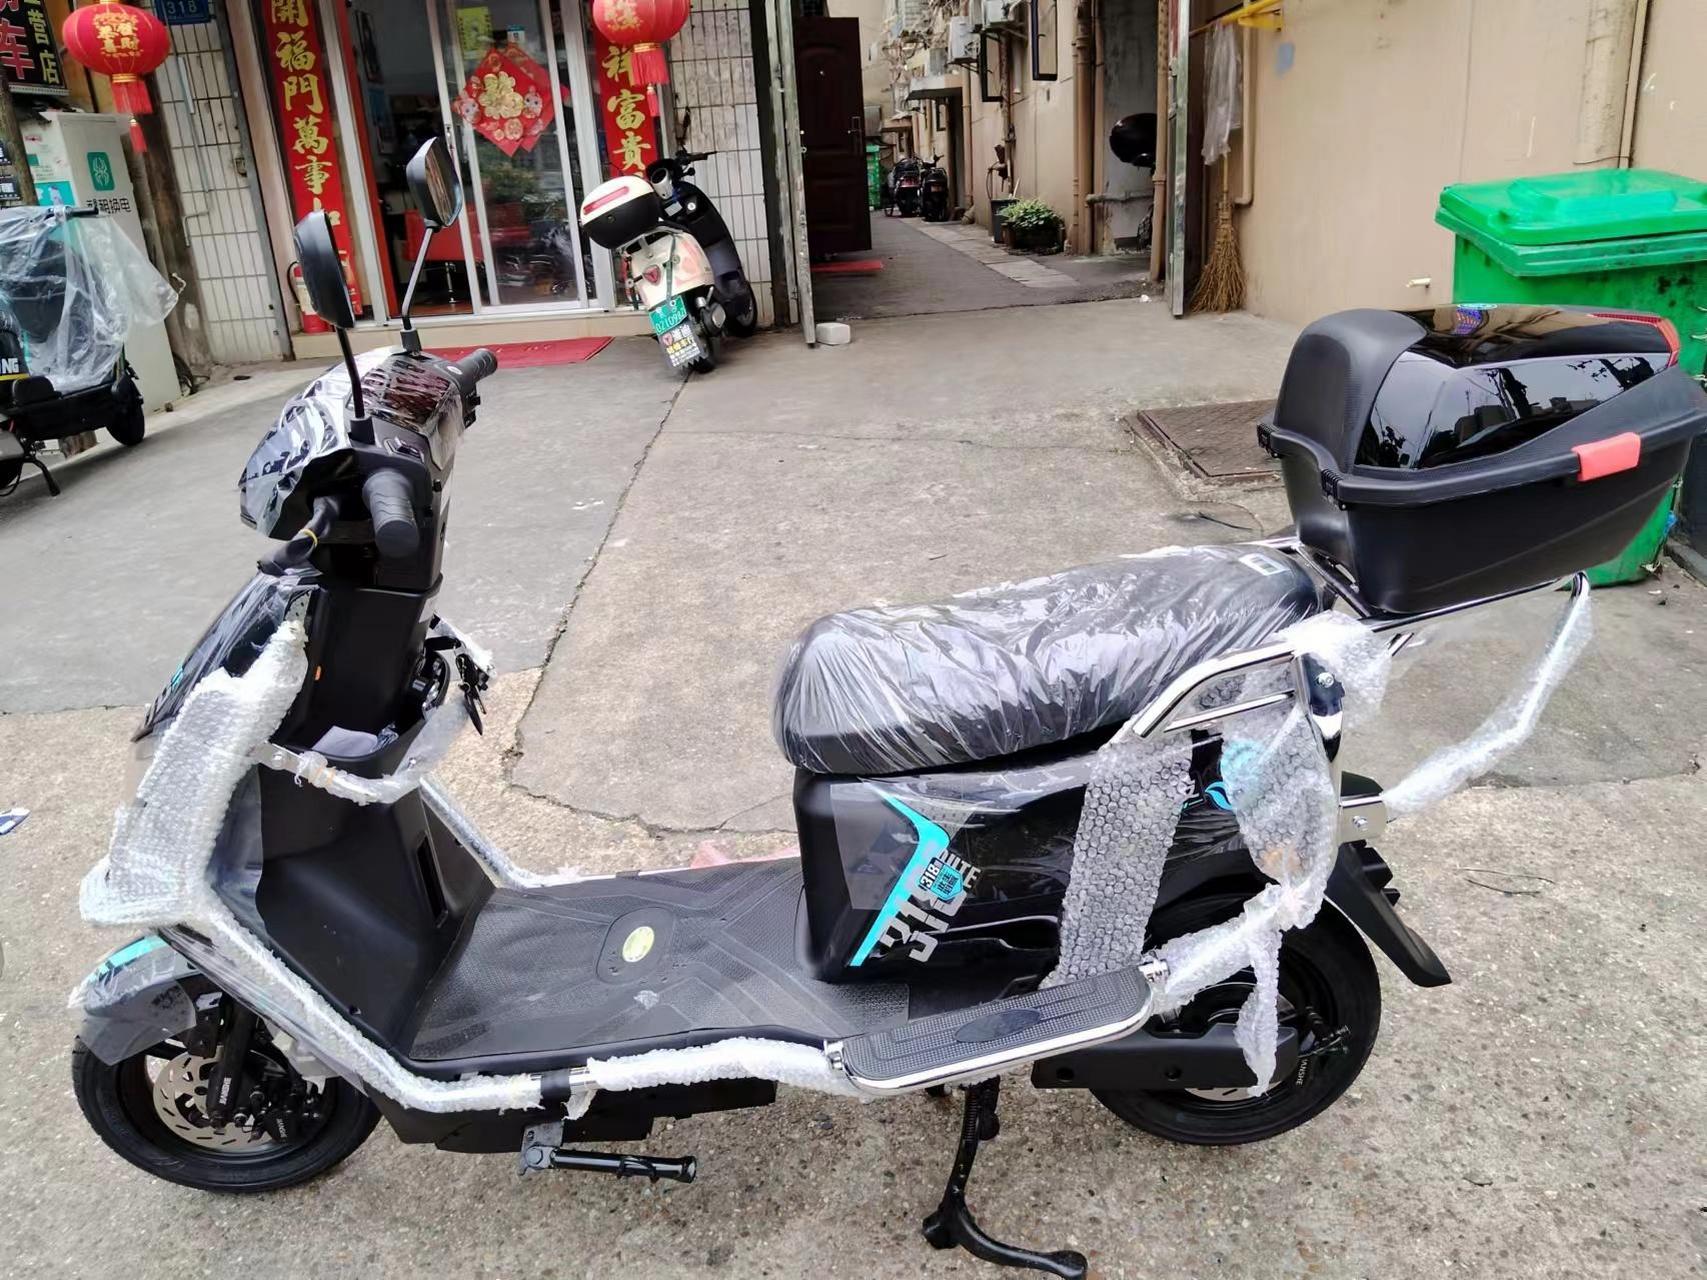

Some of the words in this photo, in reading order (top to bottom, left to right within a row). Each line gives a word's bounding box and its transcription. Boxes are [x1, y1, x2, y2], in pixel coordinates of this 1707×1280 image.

[0, 0, 35, 80] 车
[24, 0, 60, 85] 营店
[167, 0, 198, 14] 318
[269, 0, 352, 284] 開福門萬事
[601, 45, 652, 178] 祥富貴
